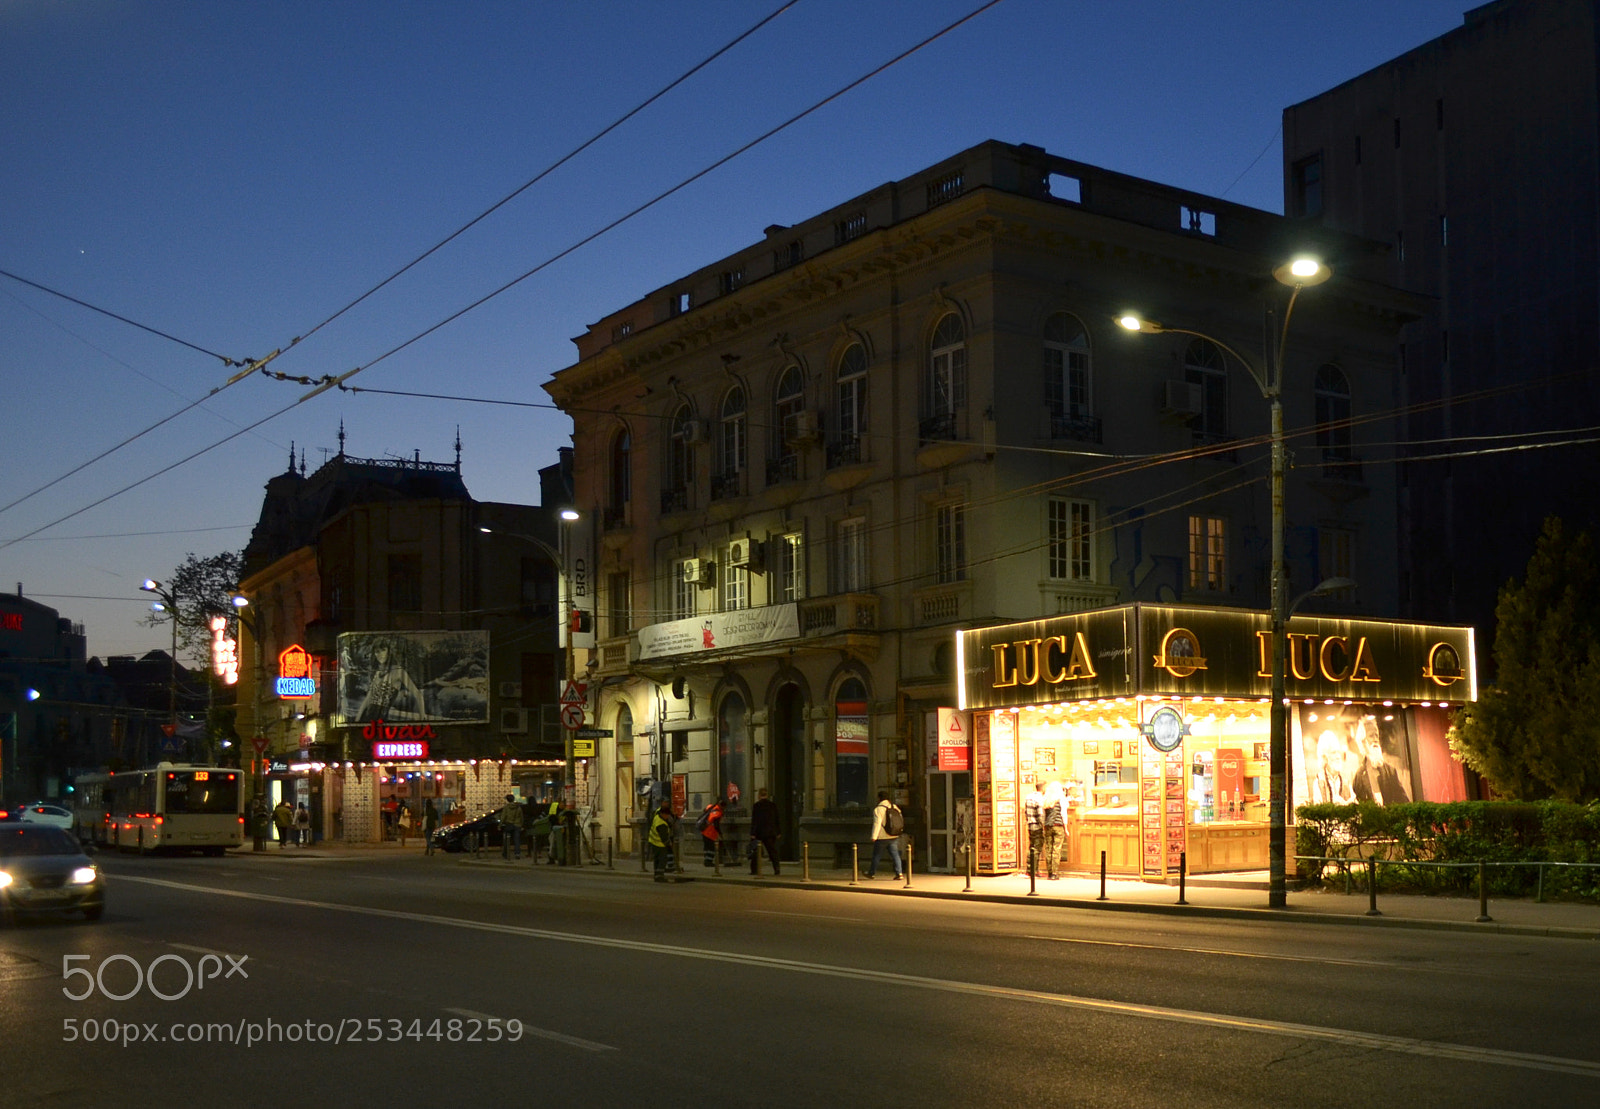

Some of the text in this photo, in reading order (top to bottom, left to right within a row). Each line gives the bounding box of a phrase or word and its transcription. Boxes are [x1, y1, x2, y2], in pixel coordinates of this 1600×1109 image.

[575, 558, 586, 597] BRD
[991, 631, 1098, 688] LUCA
[1256, 631, 1381, 682] LUCA
[277, 678, 315, 695] KEBAB
[377, 743, 423, 757] EXPRESS
[194, 771, 209, 781] 133
